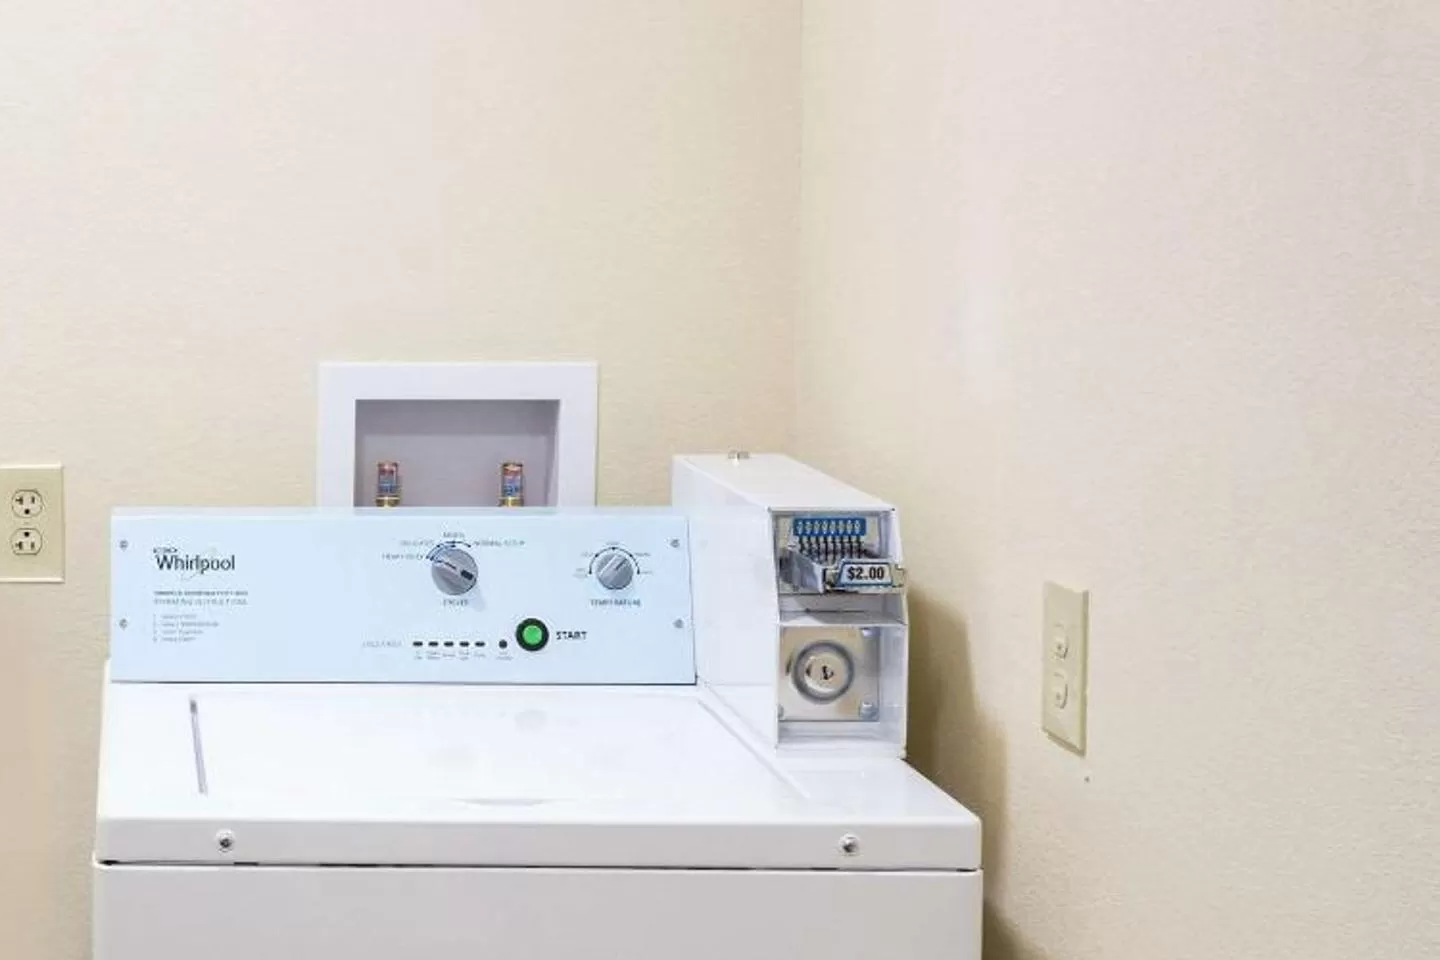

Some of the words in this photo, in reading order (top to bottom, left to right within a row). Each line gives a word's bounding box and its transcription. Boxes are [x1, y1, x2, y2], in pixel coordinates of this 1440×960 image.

[154, 554, 235, 574] Whirlpool
[847, 566, 885, 580] $2.00
[555, 631, 587, 640] START
